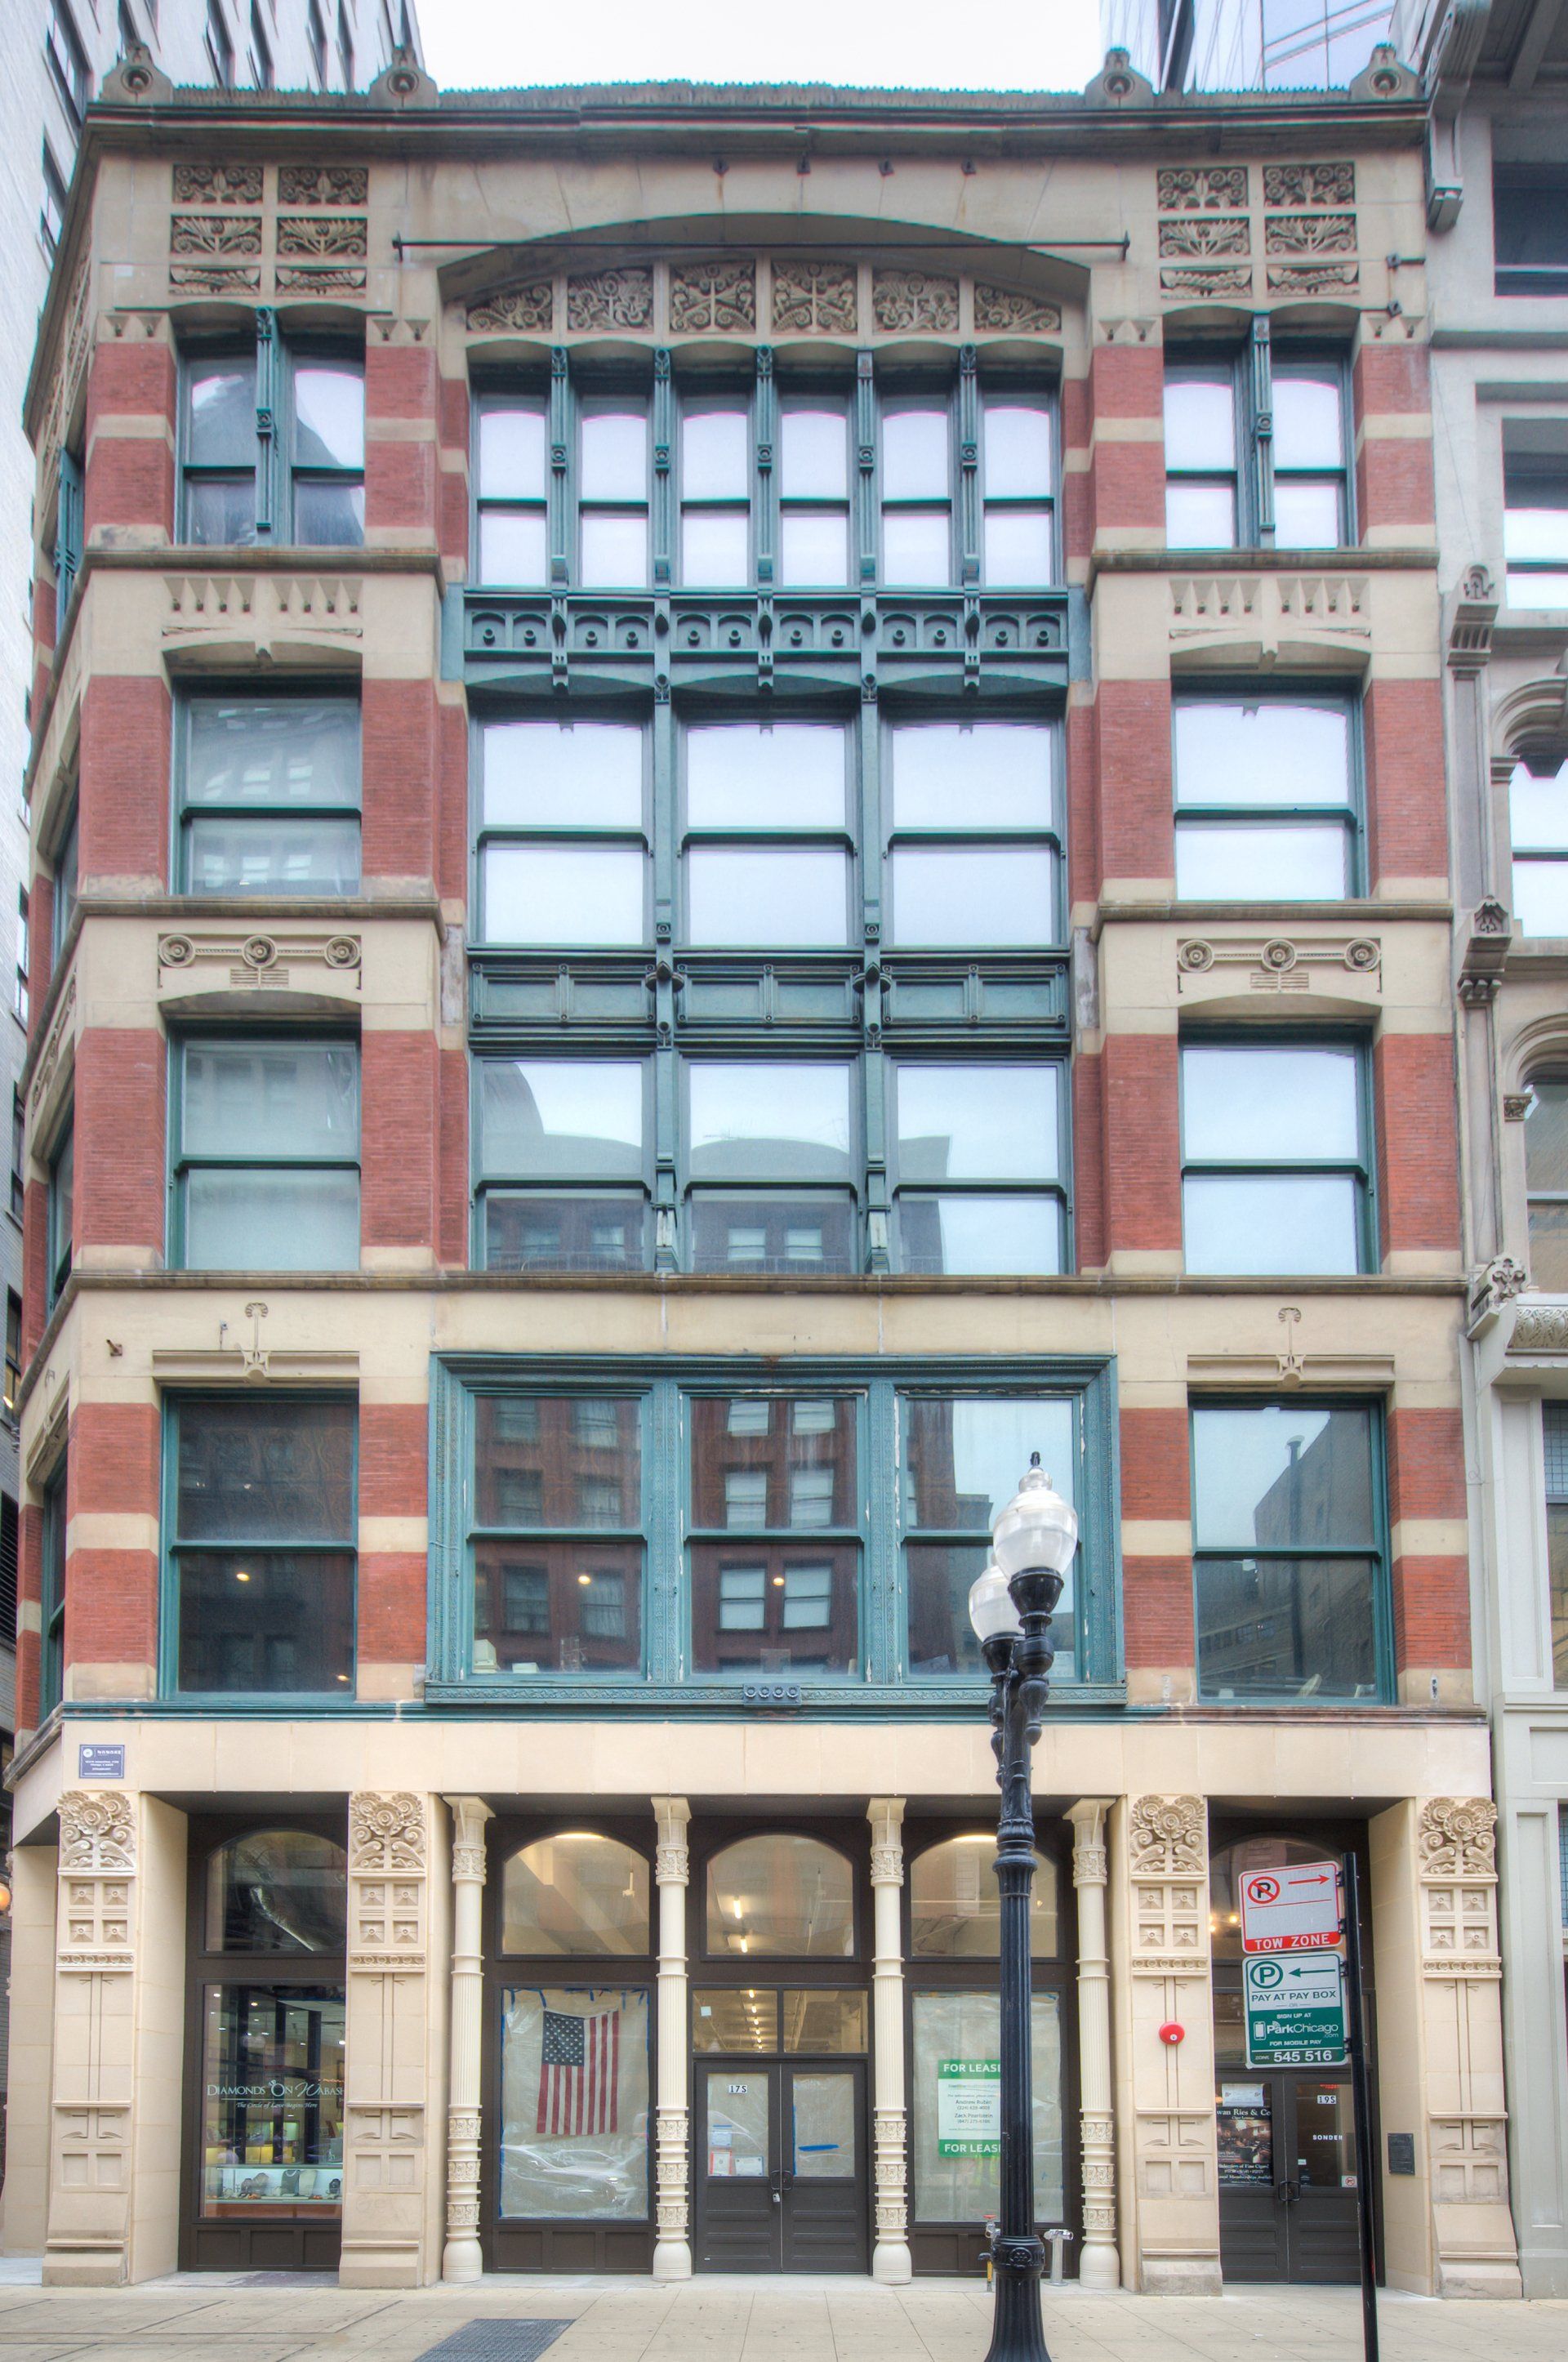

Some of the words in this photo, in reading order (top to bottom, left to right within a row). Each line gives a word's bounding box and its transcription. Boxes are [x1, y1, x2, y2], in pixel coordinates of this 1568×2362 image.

[1254, 1937, 1283, 1950] TOW
[1291, 1933, 1330, 1947] ZONE
[1259, 1967, 1276, 1984] P
[1290, 1992, 1309, 2000] PAY
[1312, 1990, 1337, 1999] BOX
[1267, 2022, 1339, 2034] ParkChicago
[1274, 2051, 1300, 2062] 545
[1305, 2050, 1332, 2061] 516
[943, 2063, 966, 2073] FOR
[207, 2084, 266, 2097] DIAMONDS
[270, 2083, 293, 2097] ON
[944, 2144, 967, 2153] FOR
